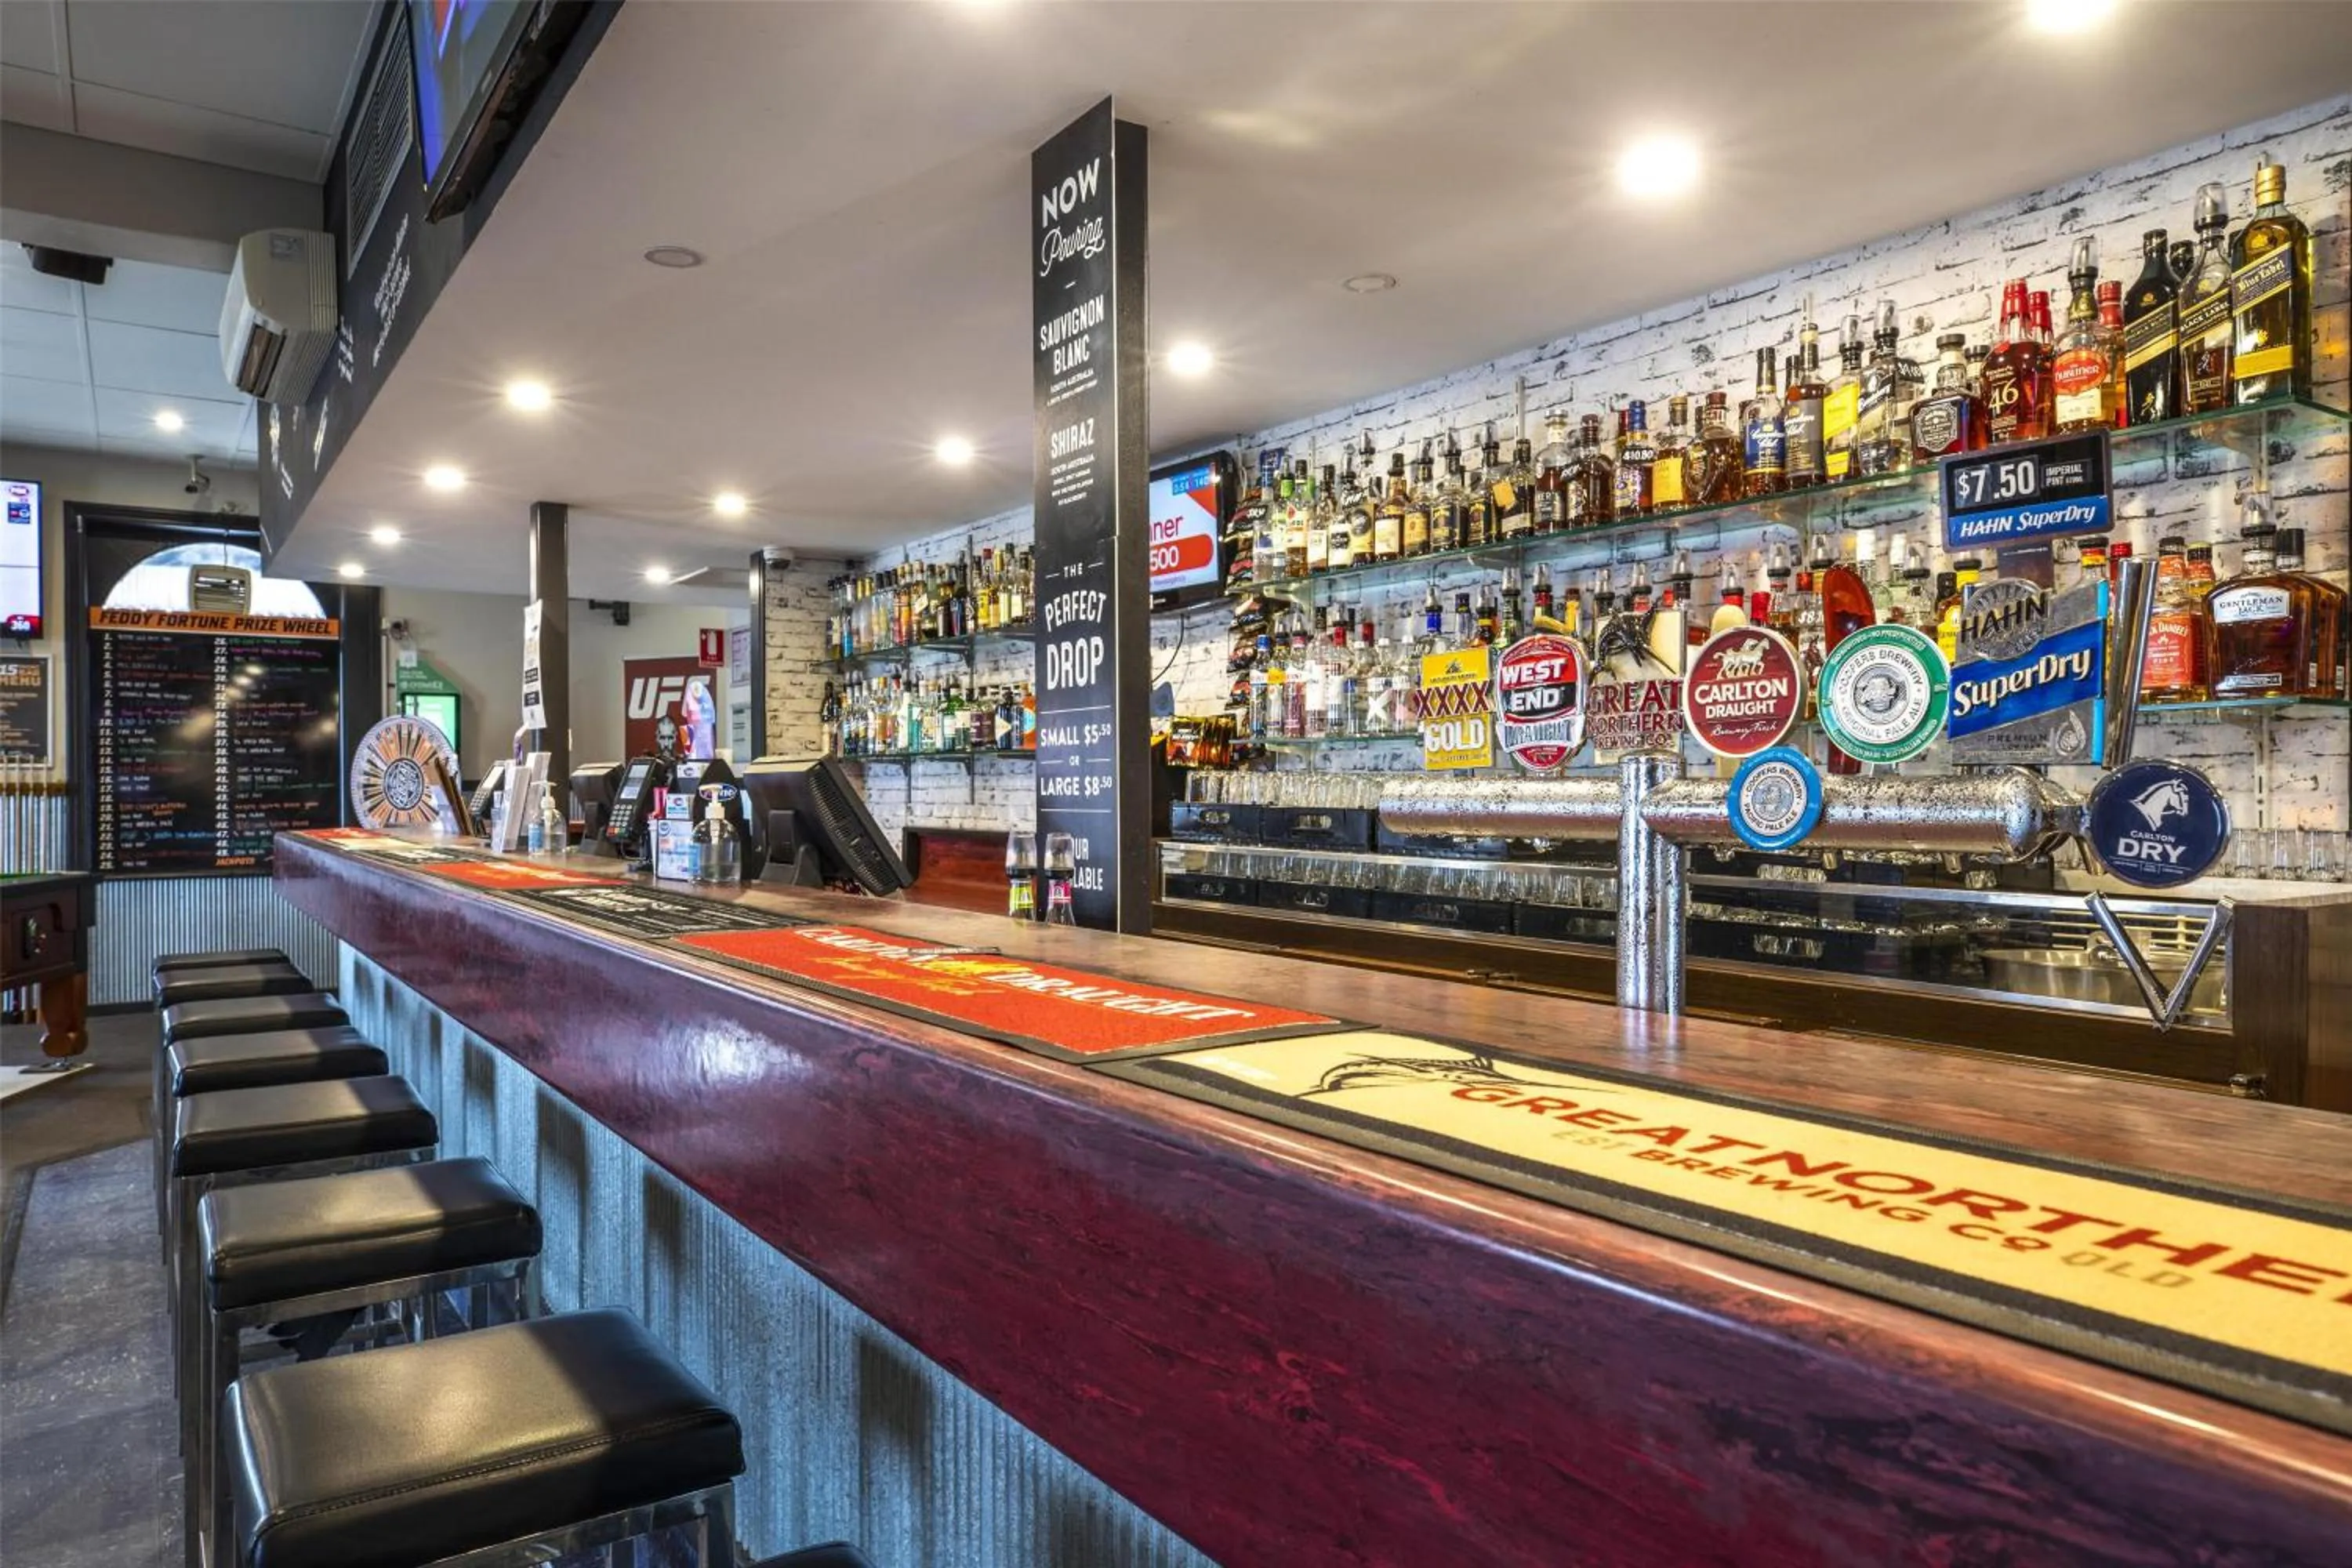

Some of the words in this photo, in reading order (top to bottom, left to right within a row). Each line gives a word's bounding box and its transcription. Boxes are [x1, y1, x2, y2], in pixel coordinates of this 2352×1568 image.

[1042, 158, 1100, 229] NOW
[1040, 216, 1105, 277] Pouring
[1040, 294, 1104, 351] SAUVIGNON
[1054, 333, 1091, 376] BLANC
[1989, 377, 2020, 416] 46
[1051, 417, 1094, 460] SHIRAZ
[1958, 460, 2034, 503] $7.50
[2045, 463, 2083, 477] IMPERIAL
[2045, 477, 2064, 487] PINT
[1149, 515, 1184, 542] ner
[1960, 515, 2014, 537] HAHN
[2016, 505, 2096, 532] SuperDry
[1063, 562, 1083, 579] THE
[1150, 546, 1179, 572] 500
[1044, 590, 1107, 633] PERFECT
[1960, 589, 2049, 644] HAHN
[2220, 596, 2284, 609] GENTLEMAN
[99, 611, 153, 626] FEDDY
[157, 613, 229, 630] FORTUNE
[234, 617, 278, 631] PRIZE
[283, 619, 332, 634] WHEEL
[1047, 636, 1105, 691] DROP
[1501, 659, 1567, 685] WEST
[1838, 650, 1876, 695] COOPERS
[1879, 649, 1923, 686] BREWERY
[1414, 680, 1490, 718] XXXX
[1587, 680, 1684, 715] GREAT
[1694, 677, 1788, 705] CARLTON
[1953, 648, 2091, 717] SuperDry
[1511, 688, 1561, 713] END
[1705, 699, 1777, 719] DRAUGHT
[1587, 712, 1684, 735] NORTHERN
[1885, 718, 1911, 738] PALE
[1911, 698, 1923, 720] ALE
[1040, 725, 1080, 747] SMALL
[1083, 723, 1112, 747] $5.50
[1425, 718, 1485, 753] GOLD
[1069, 755, 1080, 766] OR
[1040, 777, 1080, 797] LARGE
[1084, 775, 1112, 799] $8.50
[1745, 766, 1777, 793] COOPERS
[1779, 767, 1803, 800] BREWERY
[1744, 802, 1764, 829] PACIFIC
[1765, 821, 1785, 831] PALE
[1785, 810, 1798, 824] ALE
[2118, 837, 2187, 863] DRY
[2130, 829, 2176, 844] CARLTON
[1073, 866, 1103, 891] LABLE
[980, 971, 1257, 1020] DRAUGHT
[1552, 1130, 1638, 1150] EST
[1630, 1149, 1930, 1223] BREWING
[1740, 1150, 2352, 1304] NORTHE
